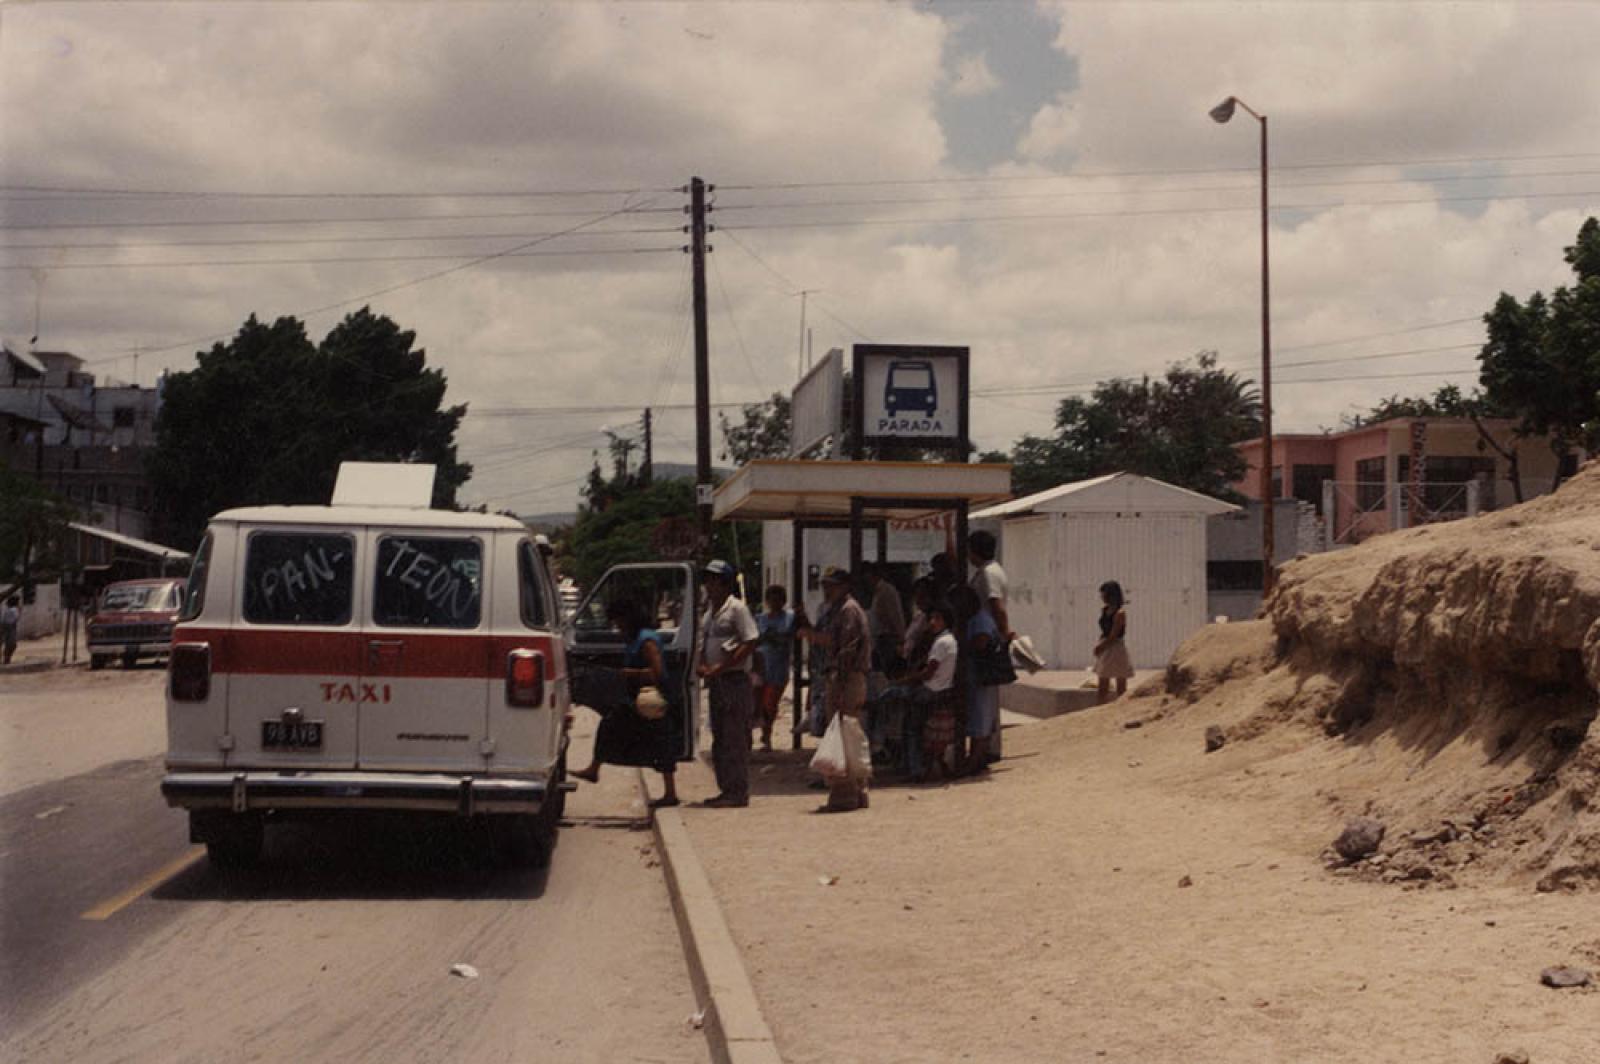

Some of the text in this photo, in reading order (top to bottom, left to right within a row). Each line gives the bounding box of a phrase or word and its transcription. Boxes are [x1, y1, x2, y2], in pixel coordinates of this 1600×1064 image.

[878, 419, 943, 432] PARADA
[261, 547, 344, 610] PAN-
[386, 540, 474, 618] TEON
[320, 682, 391, 704] TAXI
